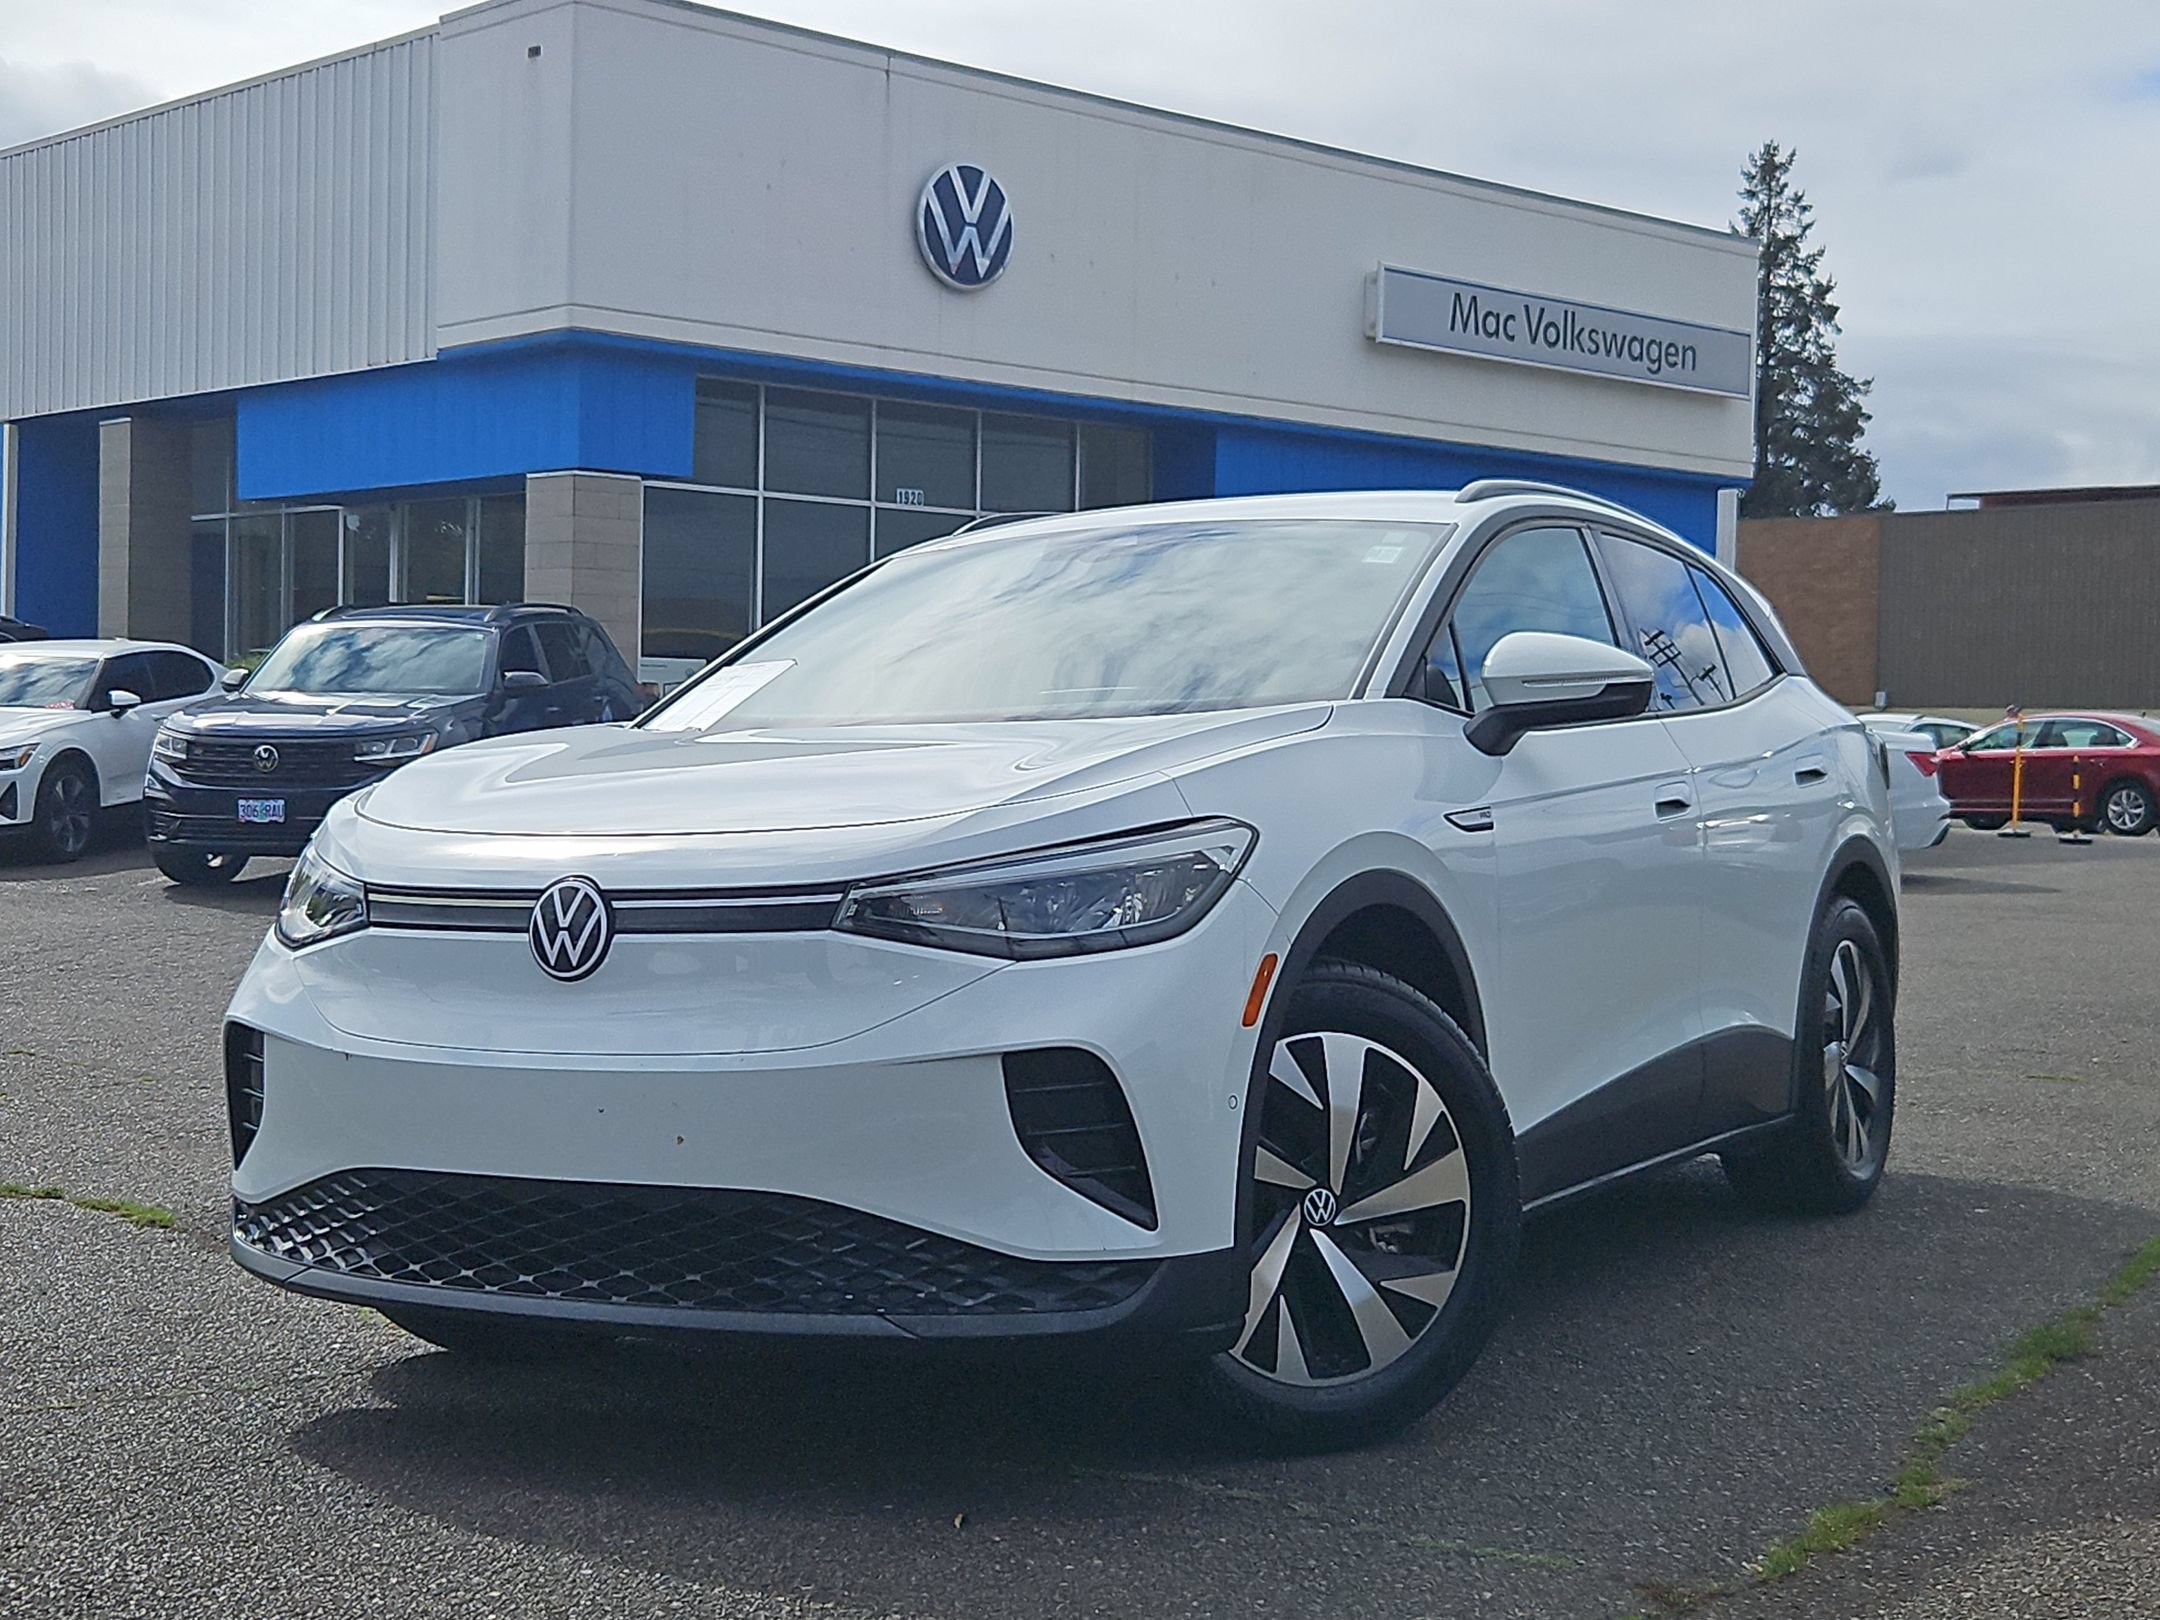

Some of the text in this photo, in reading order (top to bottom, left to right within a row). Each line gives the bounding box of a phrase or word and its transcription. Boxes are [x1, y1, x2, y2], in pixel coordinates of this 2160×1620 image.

[918, 164, 1014, 287] VW
[1449, 292, 1697, 375] Mac Volkswagen
[899, 490, 923, 506] 1920
[529, 881, 608, 978] VW
[1304, 1189, 1336, 1226] VW
